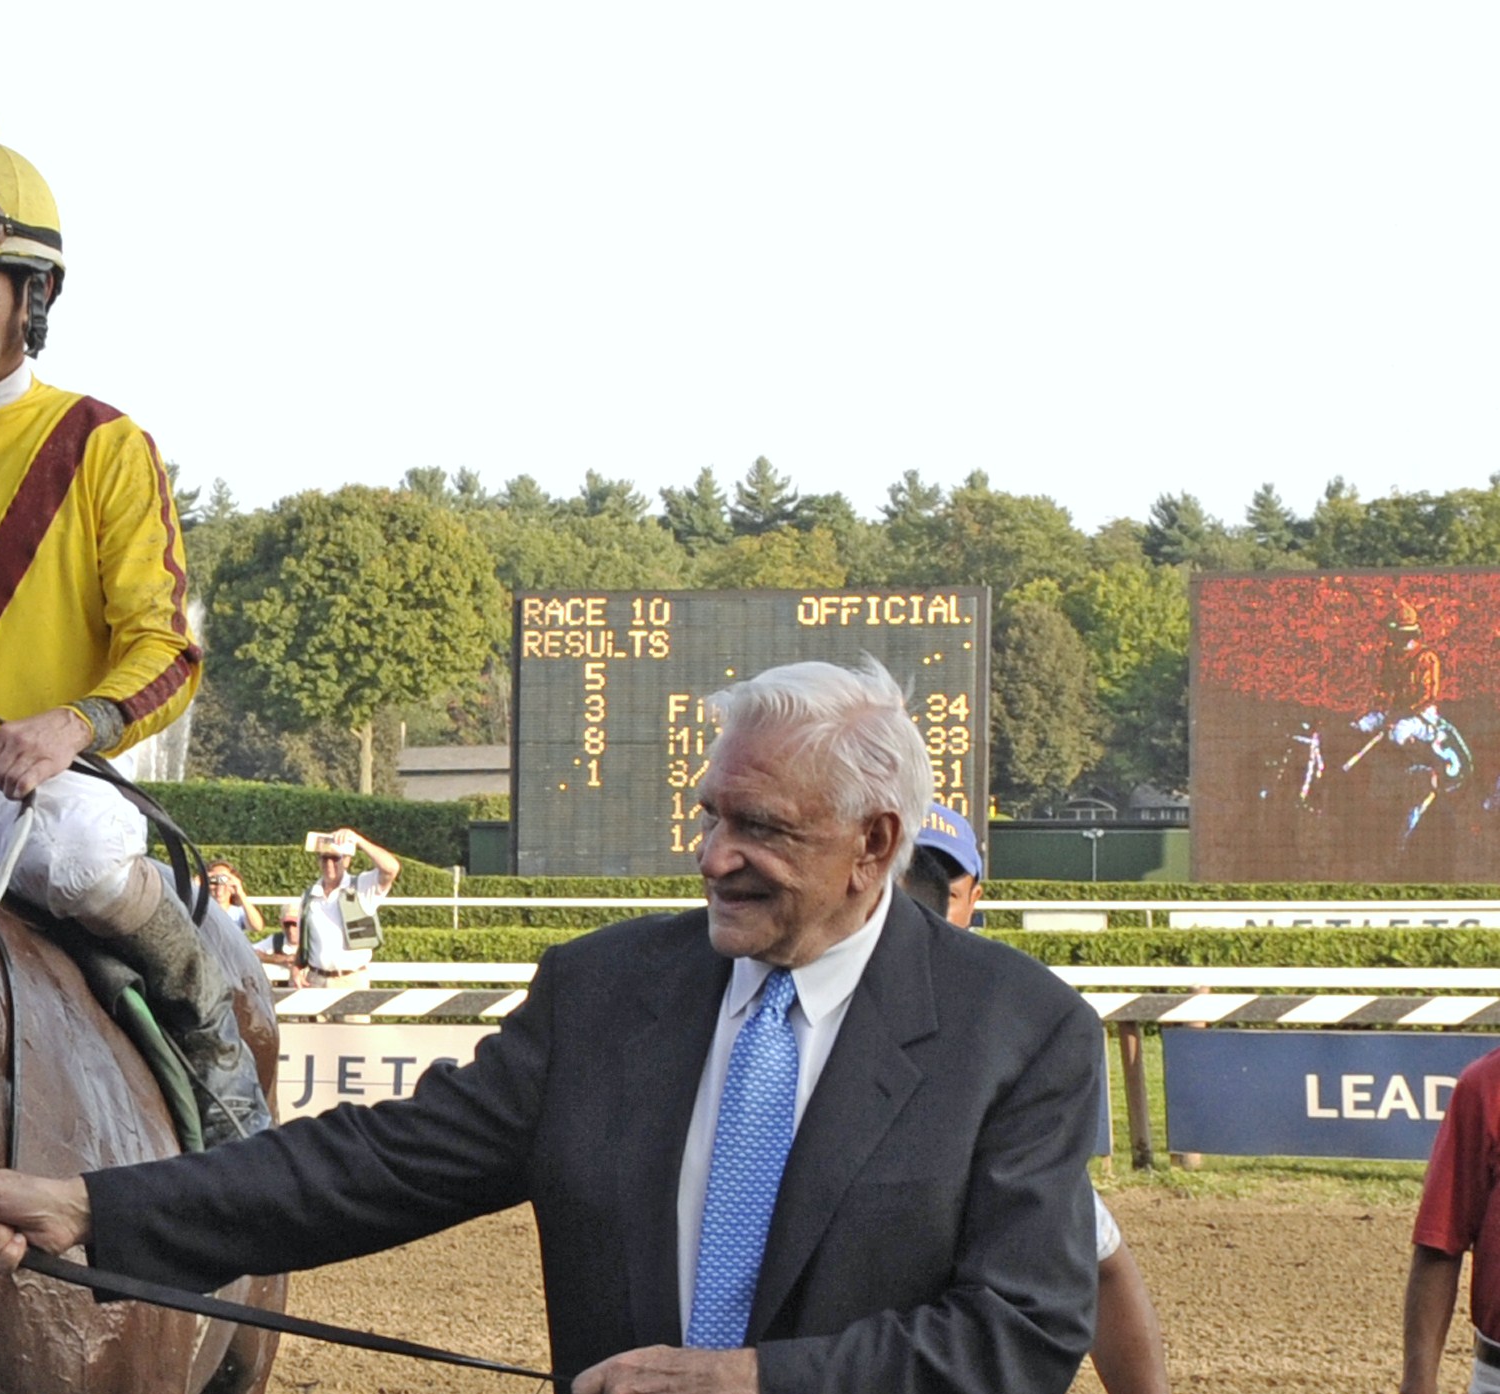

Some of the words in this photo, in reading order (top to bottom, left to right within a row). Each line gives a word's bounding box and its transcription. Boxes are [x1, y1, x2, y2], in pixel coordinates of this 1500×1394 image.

[523, 597, 607, 626] RACE
[632, 597, 671, 626] 10
[797, 594, 972, 626] OFFICIAL
[522, 630, 670, 659] RESULTS
[584, 662, 606, 690] 5
[584, 694, 606, 722] 3
[584, 726, 606, 755] 8
[587, 759, 601, 787] 1
[1305, 1073, 1458, 1121] LEAD
